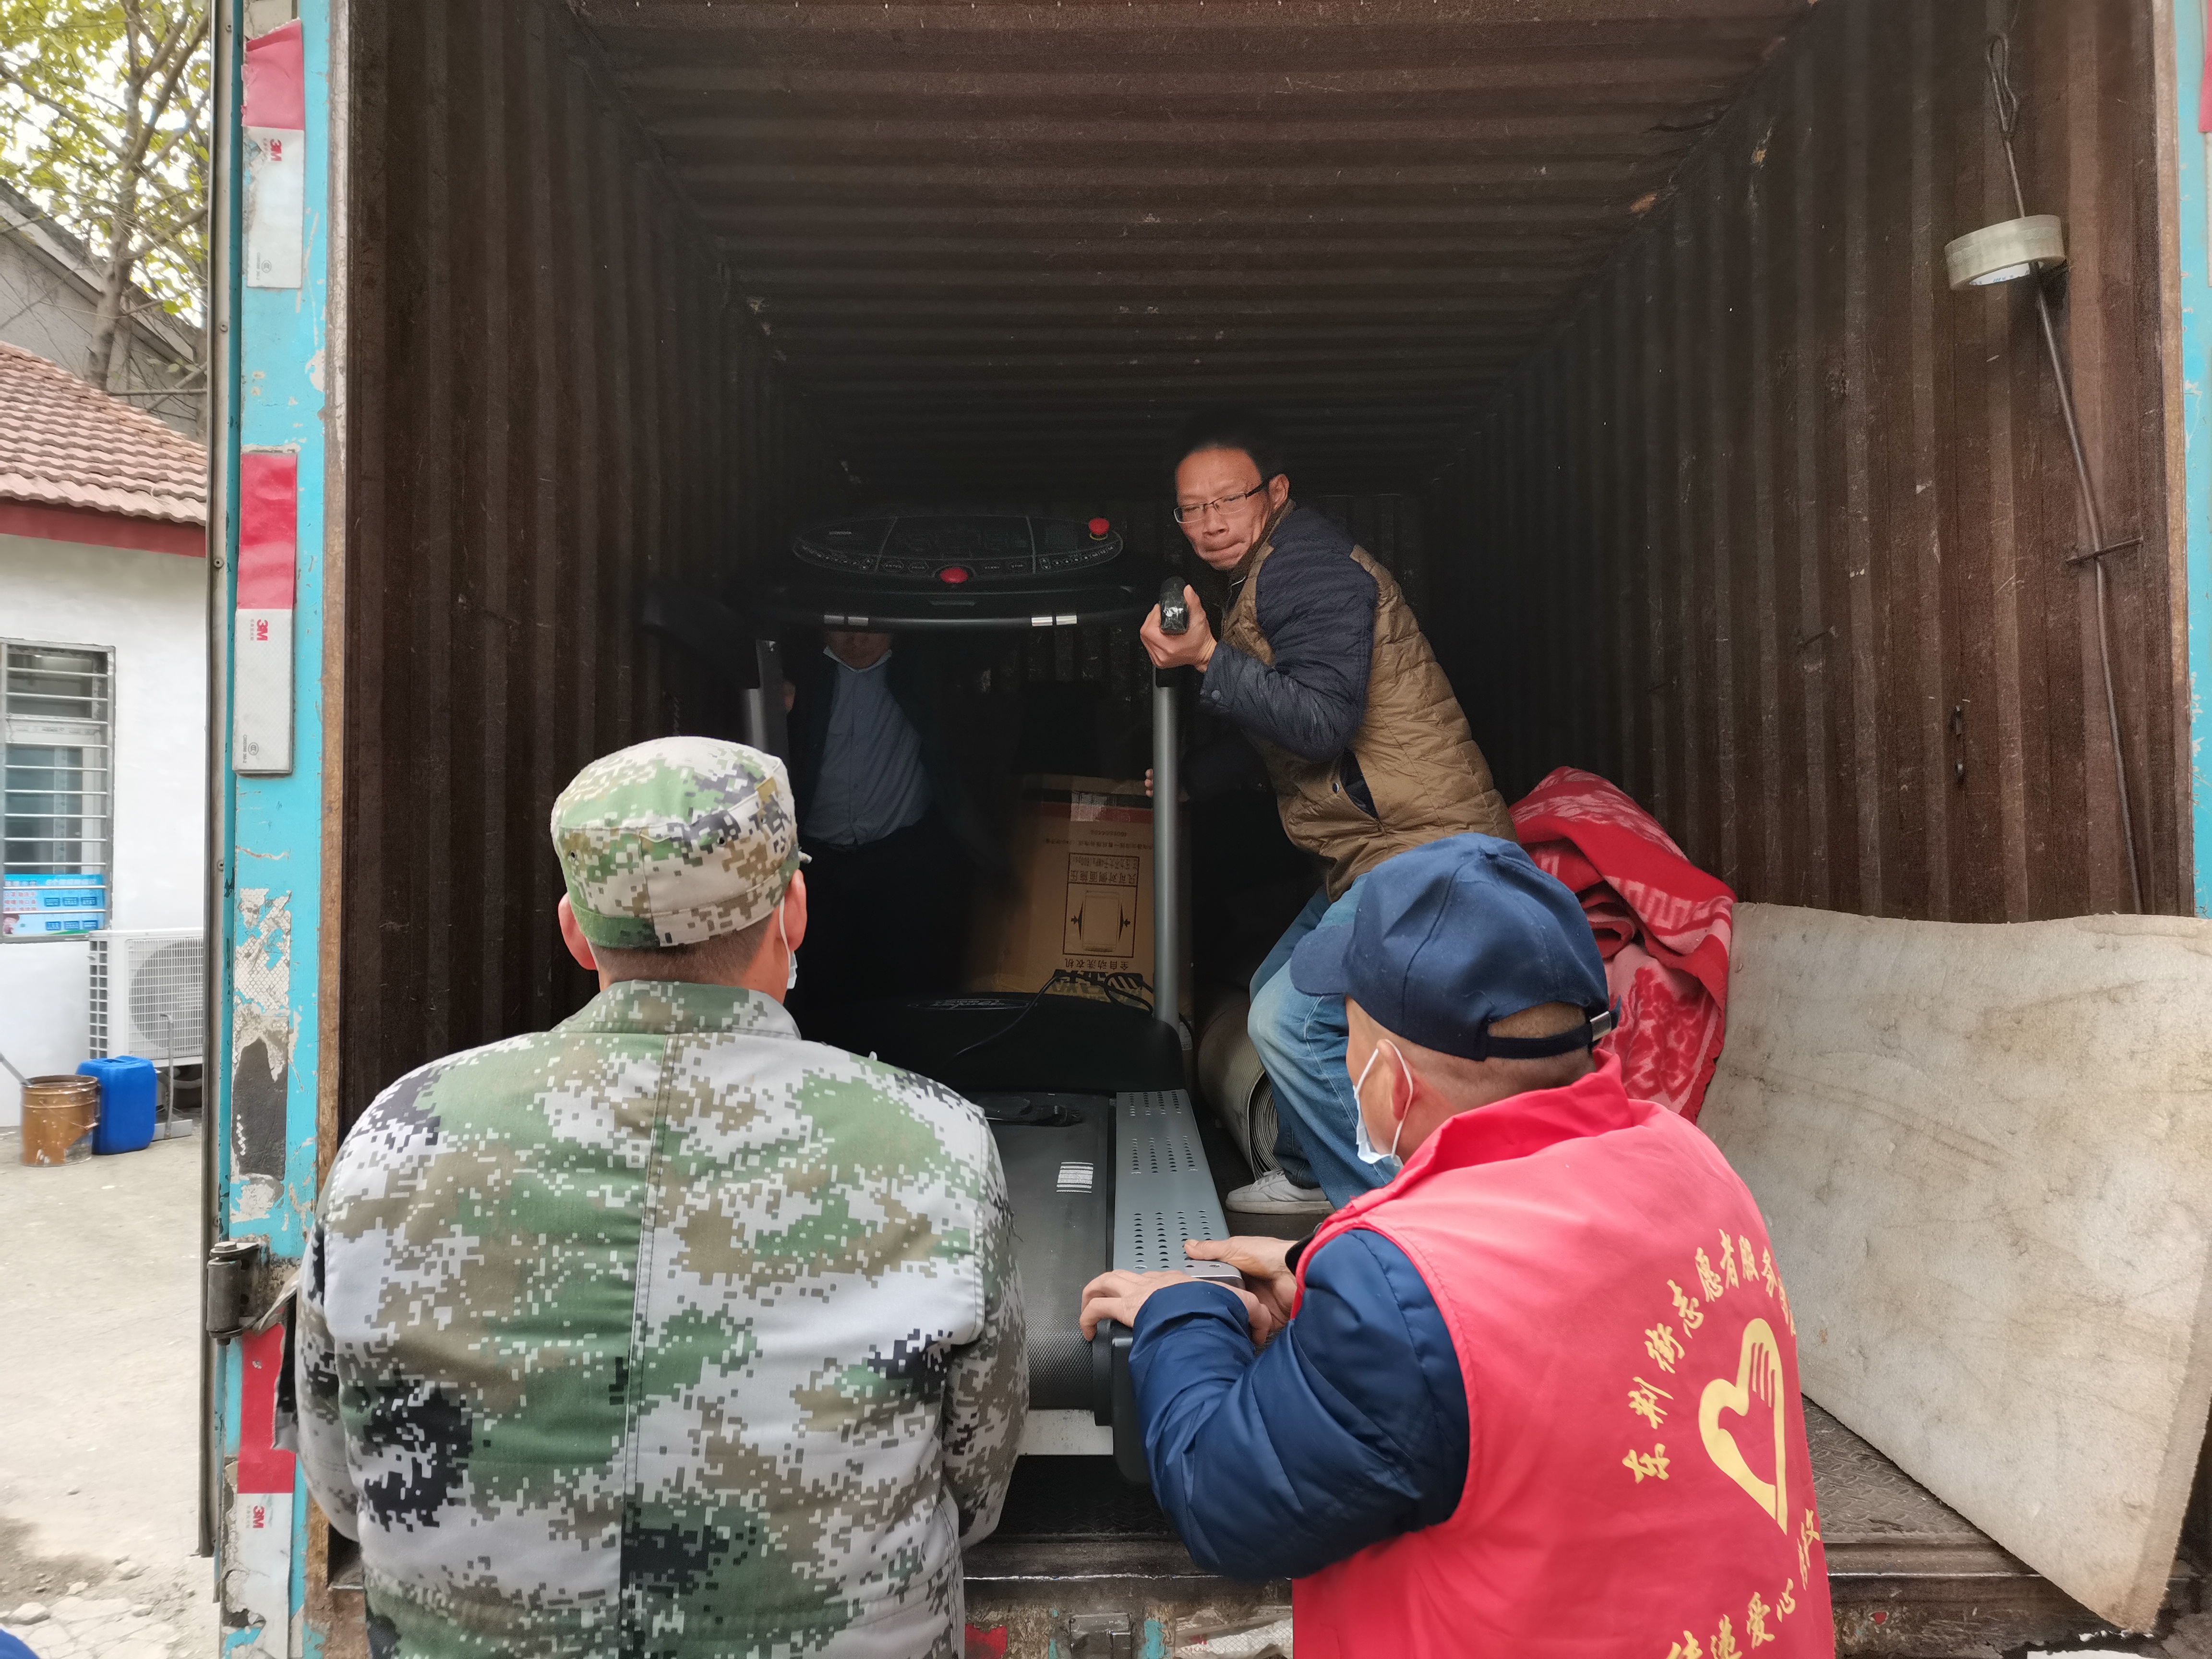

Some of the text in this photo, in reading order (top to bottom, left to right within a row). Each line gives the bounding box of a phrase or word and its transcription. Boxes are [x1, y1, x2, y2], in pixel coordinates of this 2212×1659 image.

[270, 139, 282, 161] 3M
[256, 619, 268, 641] 3M
[1065, 958, 1129, 971] 全自动洗衣机
[252, 1505, 264, 1528] 3M
